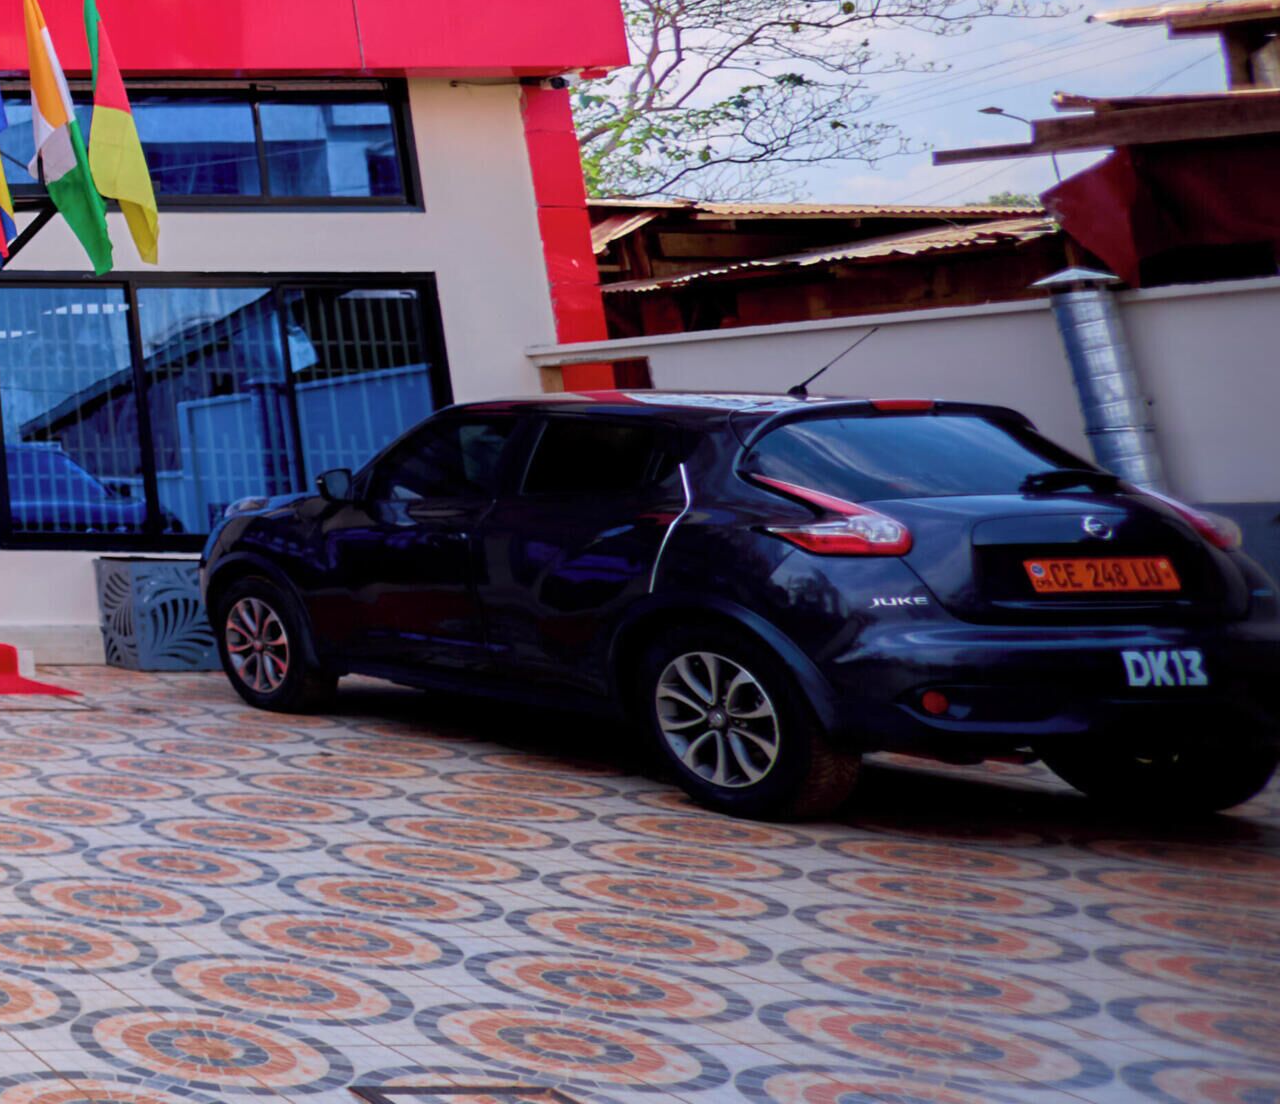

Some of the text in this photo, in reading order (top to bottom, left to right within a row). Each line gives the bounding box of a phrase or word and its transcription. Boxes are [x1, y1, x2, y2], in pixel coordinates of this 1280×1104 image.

[1048, 562, 1083, 588] CE
[1085, 562, 1128, 588] 248
[868, 596, 929, 609] JUKE
[1121, 650, 1209, 687] DK13
